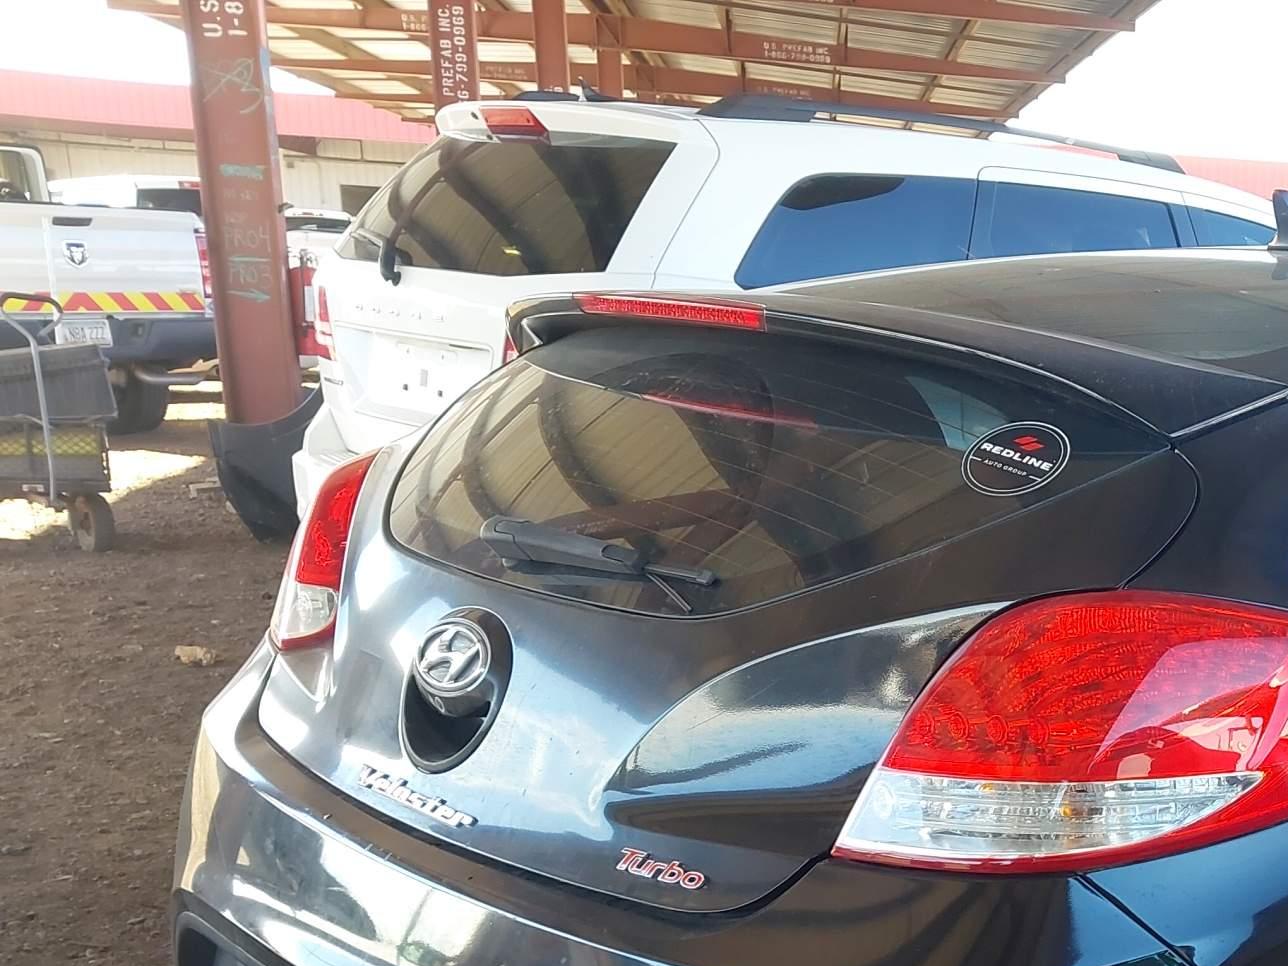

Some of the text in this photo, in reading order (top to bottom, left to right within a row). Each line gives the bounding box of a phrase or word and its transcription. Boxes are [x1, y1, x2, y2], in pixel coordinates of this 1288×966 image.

[437, 4, 455, 97] PREFAB INC.
[980, 442, 1054, 472] REDLINE
[983, 459, 1028, 477] AUTO GROUP
[359, 763, 479, 829] Veloster
[616, 847, 705, 890] Turbo
